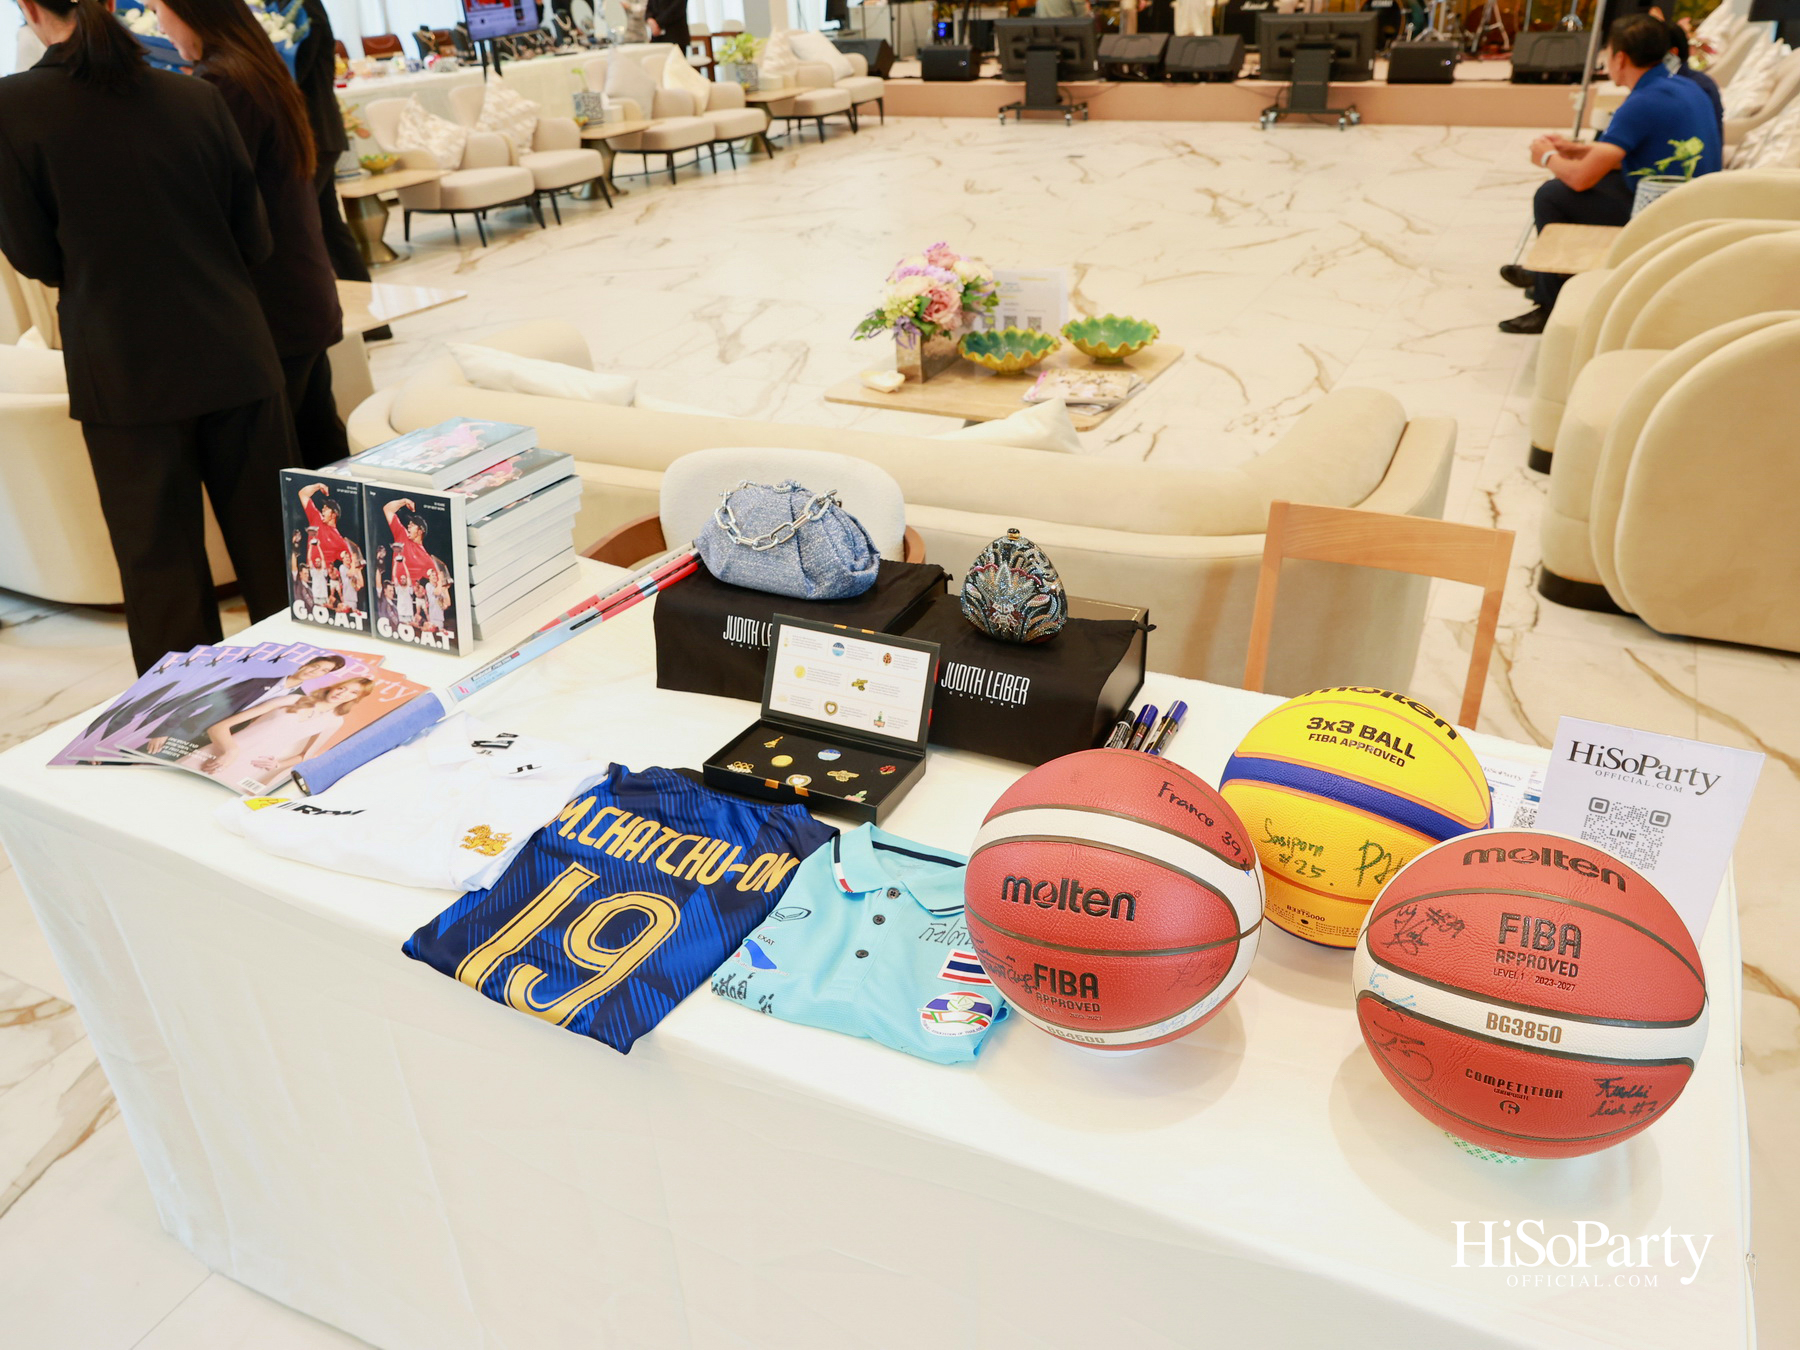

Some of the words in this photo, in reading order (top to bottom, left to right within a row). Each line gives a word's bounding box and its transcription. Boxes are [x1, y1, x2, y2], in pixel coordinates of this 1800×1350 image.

[292, 599, 368, 631] G.O.A.T
[723, 614, 760, 646] JUDITH
[377, 616, 455, 650] G.O.A.T
[940, 661, 986, 696] JUDITH
[985, 670, 1030, 705] LEIBER
[1306, 716, 1355, 735] 3x3
[1358, 724, 1417, 760] BALL
[1308, 733, 1338, 745] FIBA
[1339, 738, 1406, 768] APPROVED
[1566, 739, 1722, 796] HiSoParty
[1594, 768, 1684, 794] OFFICIAL.COM
[545, 795, 801, 893] M.CHATCHU-ON
[1608, 827, 1637, 842] LINE
[1462, 846, 1628, 893] molten
[1000, 873, 1138, 922] molten
[455, 861, 681, 1028] 19
[757, 933, 776, 947] EXAT
[1497, 911, 1583, 960] FIBA
[1033, 962, 1100, 1001] FIBA
[1492, 967, 1520, 981] LEVEL
[1533, 974, 1577, 993] 2023-2027
[1494, 948, 1580, 980] APPROVED
[1035, 991, 1101, 1013] APPROVED
[1484, 1010, 1563, 1045] BG3850
[1464, 1067, 1564, 1100] COMPETITION
